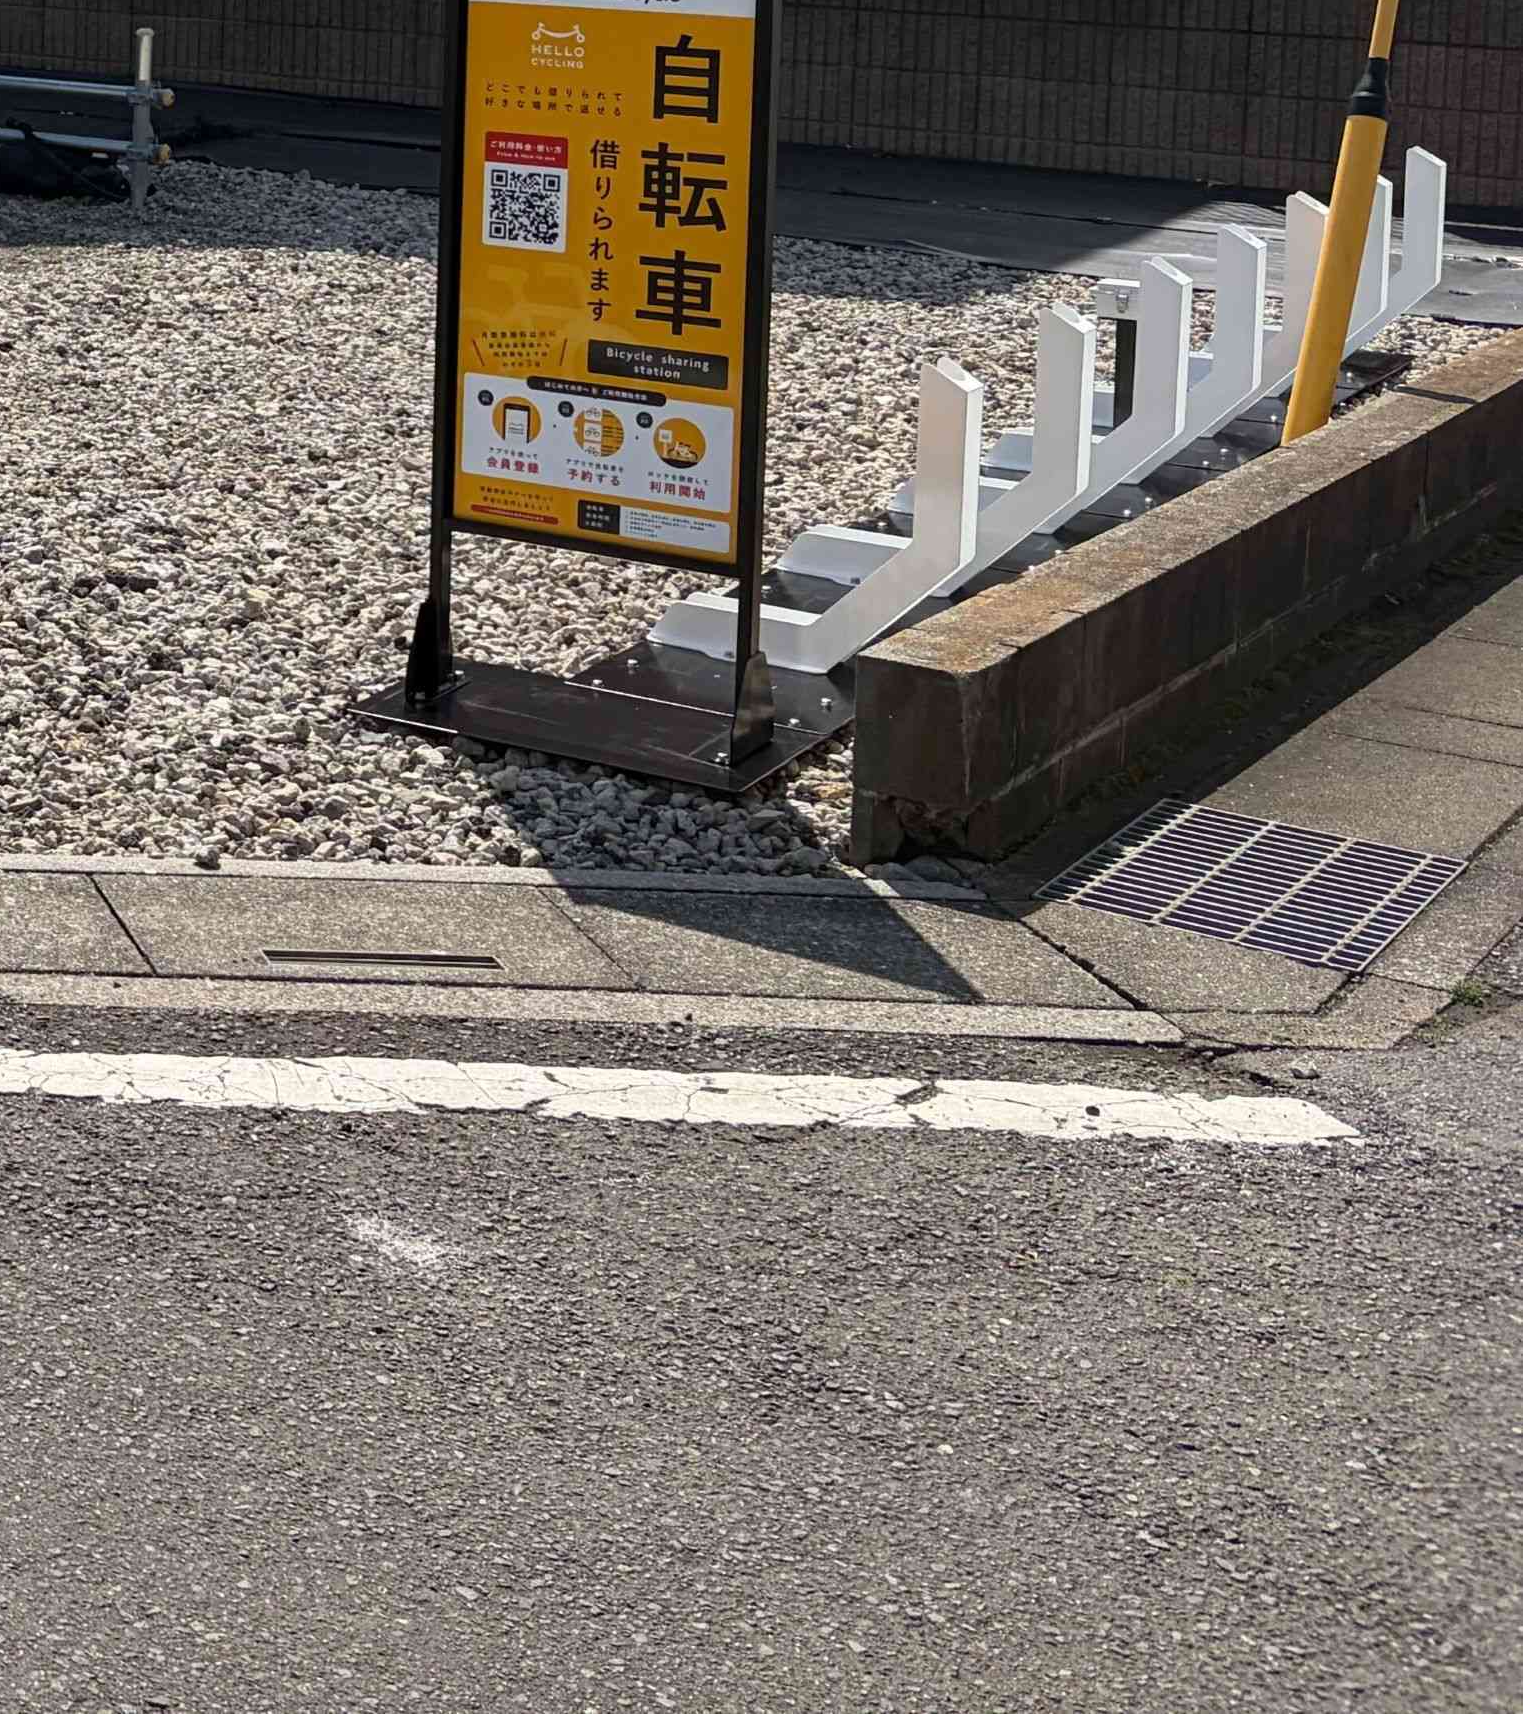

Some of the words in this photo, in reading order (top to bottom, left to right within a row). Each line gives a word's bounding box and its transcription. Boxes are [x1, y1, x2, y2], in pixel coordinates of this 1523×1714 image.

[531, 44, 585, 58] HELLO
[531, 57, 584, 70] CYCLING
[635, 34, 728, 336] 自転車
[587, 139, 621, 322] 借りられます
[605, 346, 654, 364] Bicycle
[661, 352, 710, 374] sharing
[633, 363, 682, 380] station
[486, 455, 540, 474] 会員登録
[567, 467, 622, 487] 予約する
[649, 480, 707, 501] 利用開始
